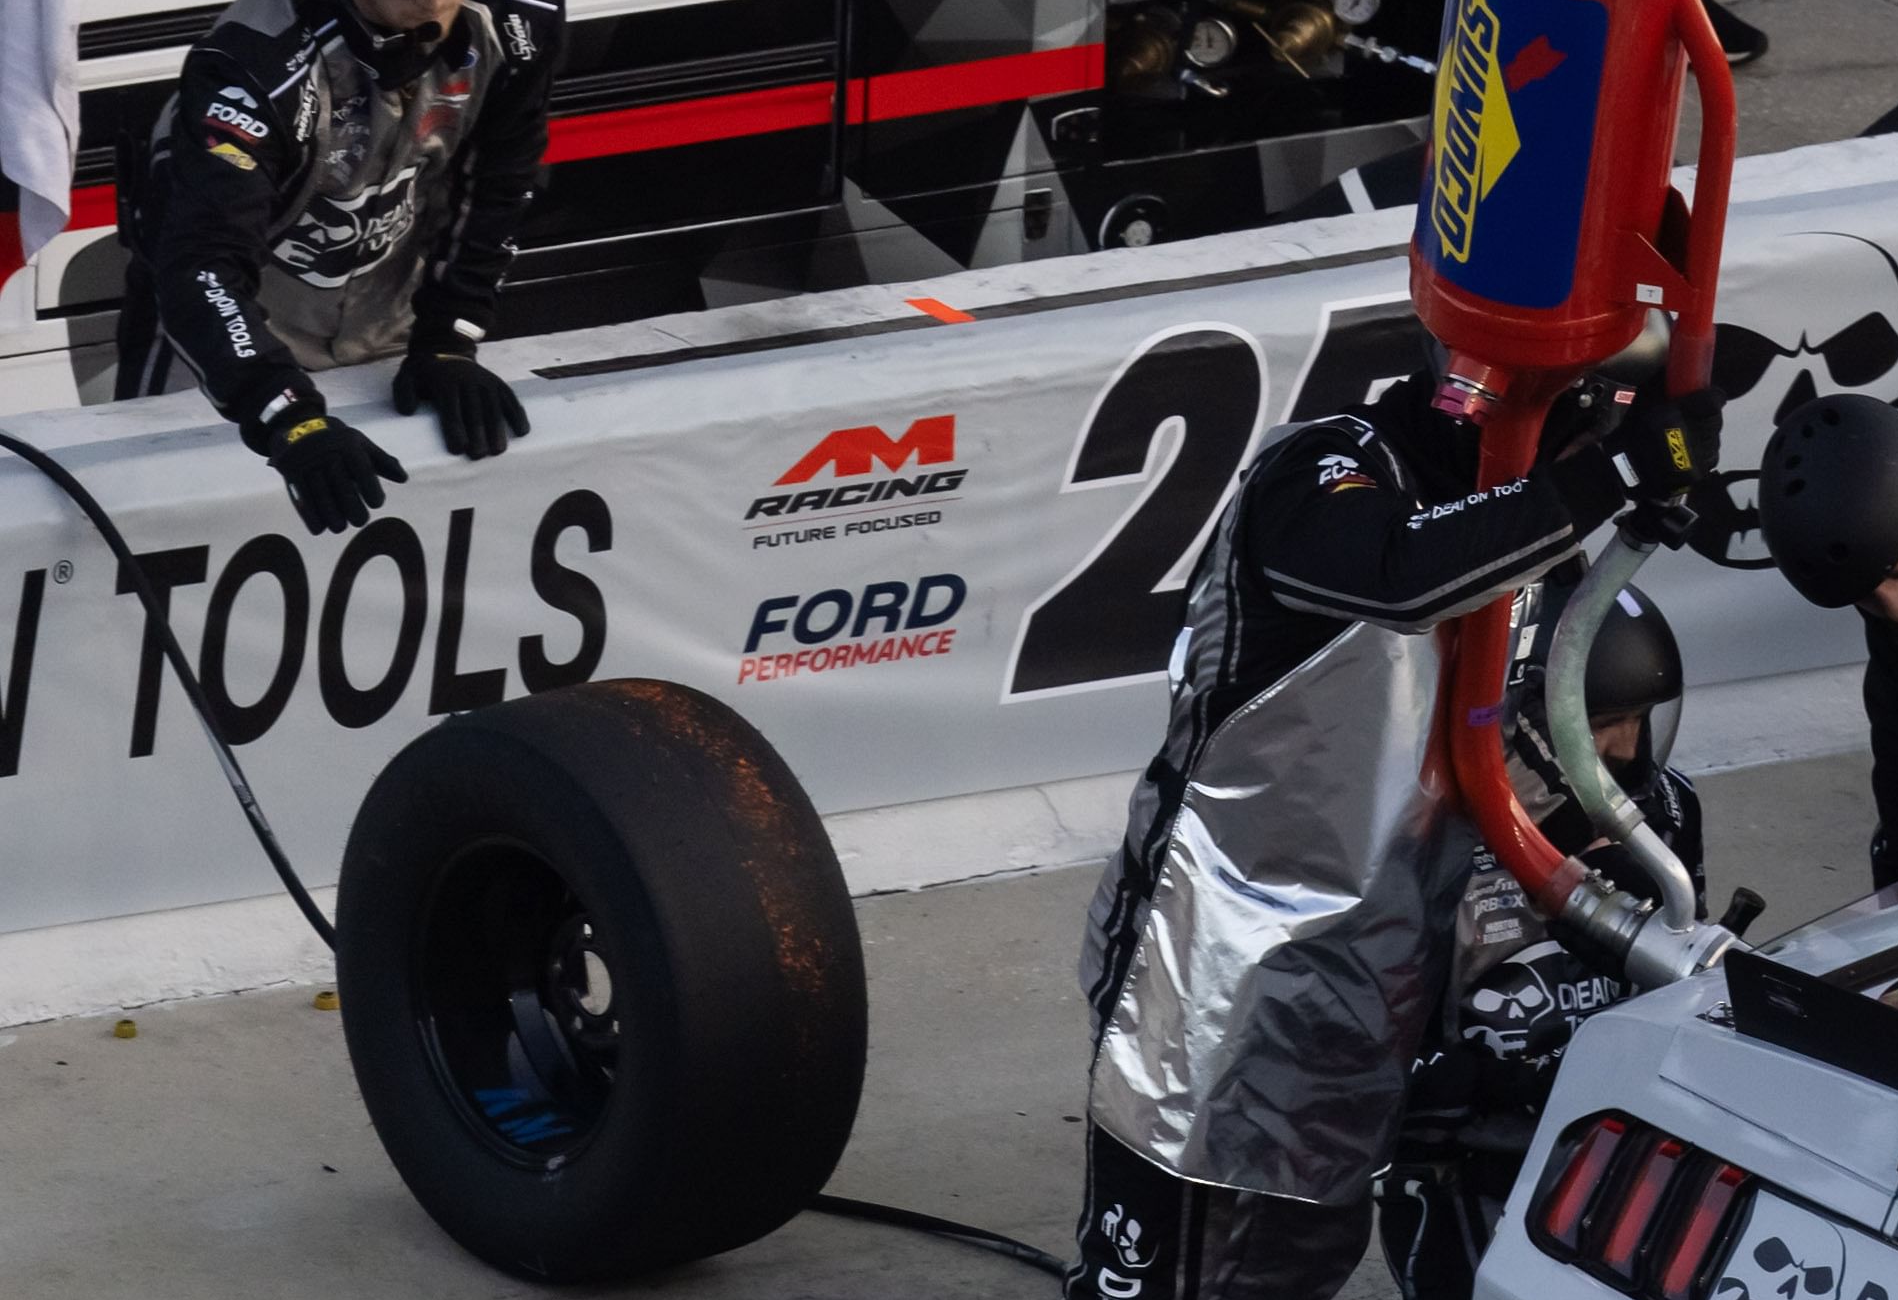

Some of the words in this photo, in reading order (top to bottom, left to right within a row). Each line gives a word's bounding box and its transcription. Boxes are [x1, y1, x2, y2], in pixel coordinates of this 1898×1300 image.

[206, 103, 270, 138] FORD
[226, 310, 256, 359] TOOLS
[771, 414, 955, 486] AM
[743, 469, 969, 520] RACING
[1467, 491, 1488, 506] ON
[753, 526, 836, 549] FUTURE
[845, 510, 941, 537] FOCUSED
[115, 489, 613, 758] TOOLS
[743, 573, 967, 654] FORD
[737, 629, 956, 685] PERFORMANCE
